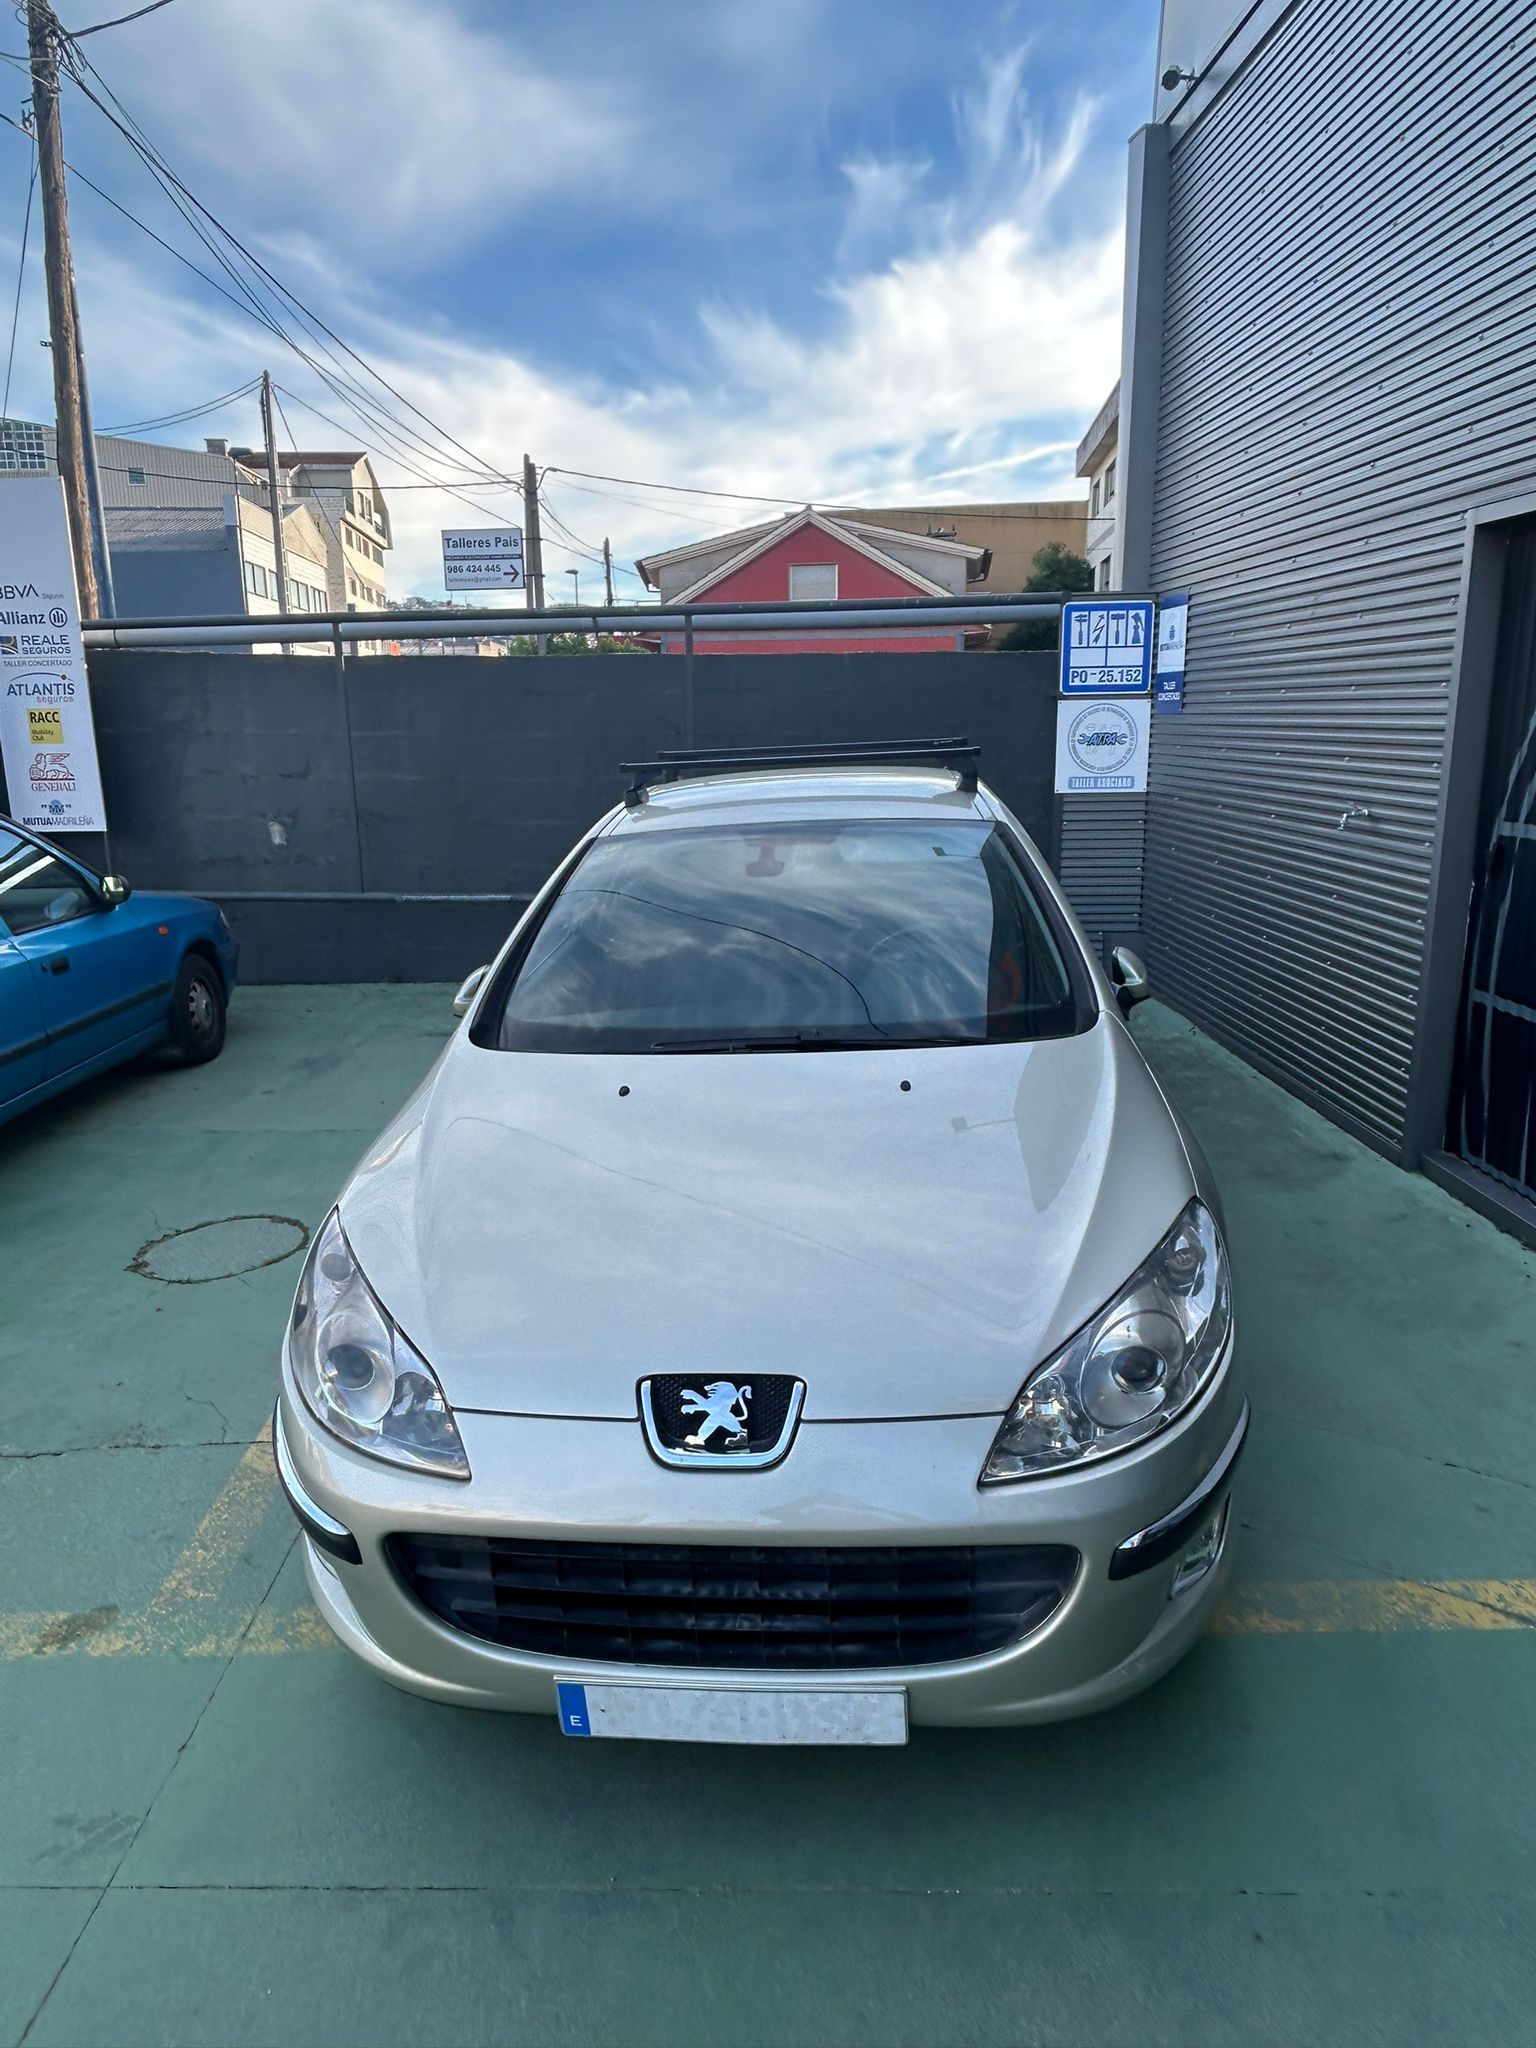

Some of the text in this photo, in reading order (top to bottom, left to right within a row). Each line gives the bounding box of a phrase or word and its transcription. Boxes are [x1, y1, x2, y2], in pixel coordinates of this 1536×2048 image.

[444, 537, 491, 549] Talleres
[447, 564, 501, 573] 986 424 445
[21, 634, 69, 645] REALE
[22, 646, 71, 655] SEGUROS
[28, 659, 72, 667] CONCERTADO
[7, 683, 75, 696] ATLANTIS
[36, 696, 74, 704] seguros
[29, 711, 60, 723] RACC
[31, 782, 76, 792] GENERALI
[570, 1715, 582, 1726] E
